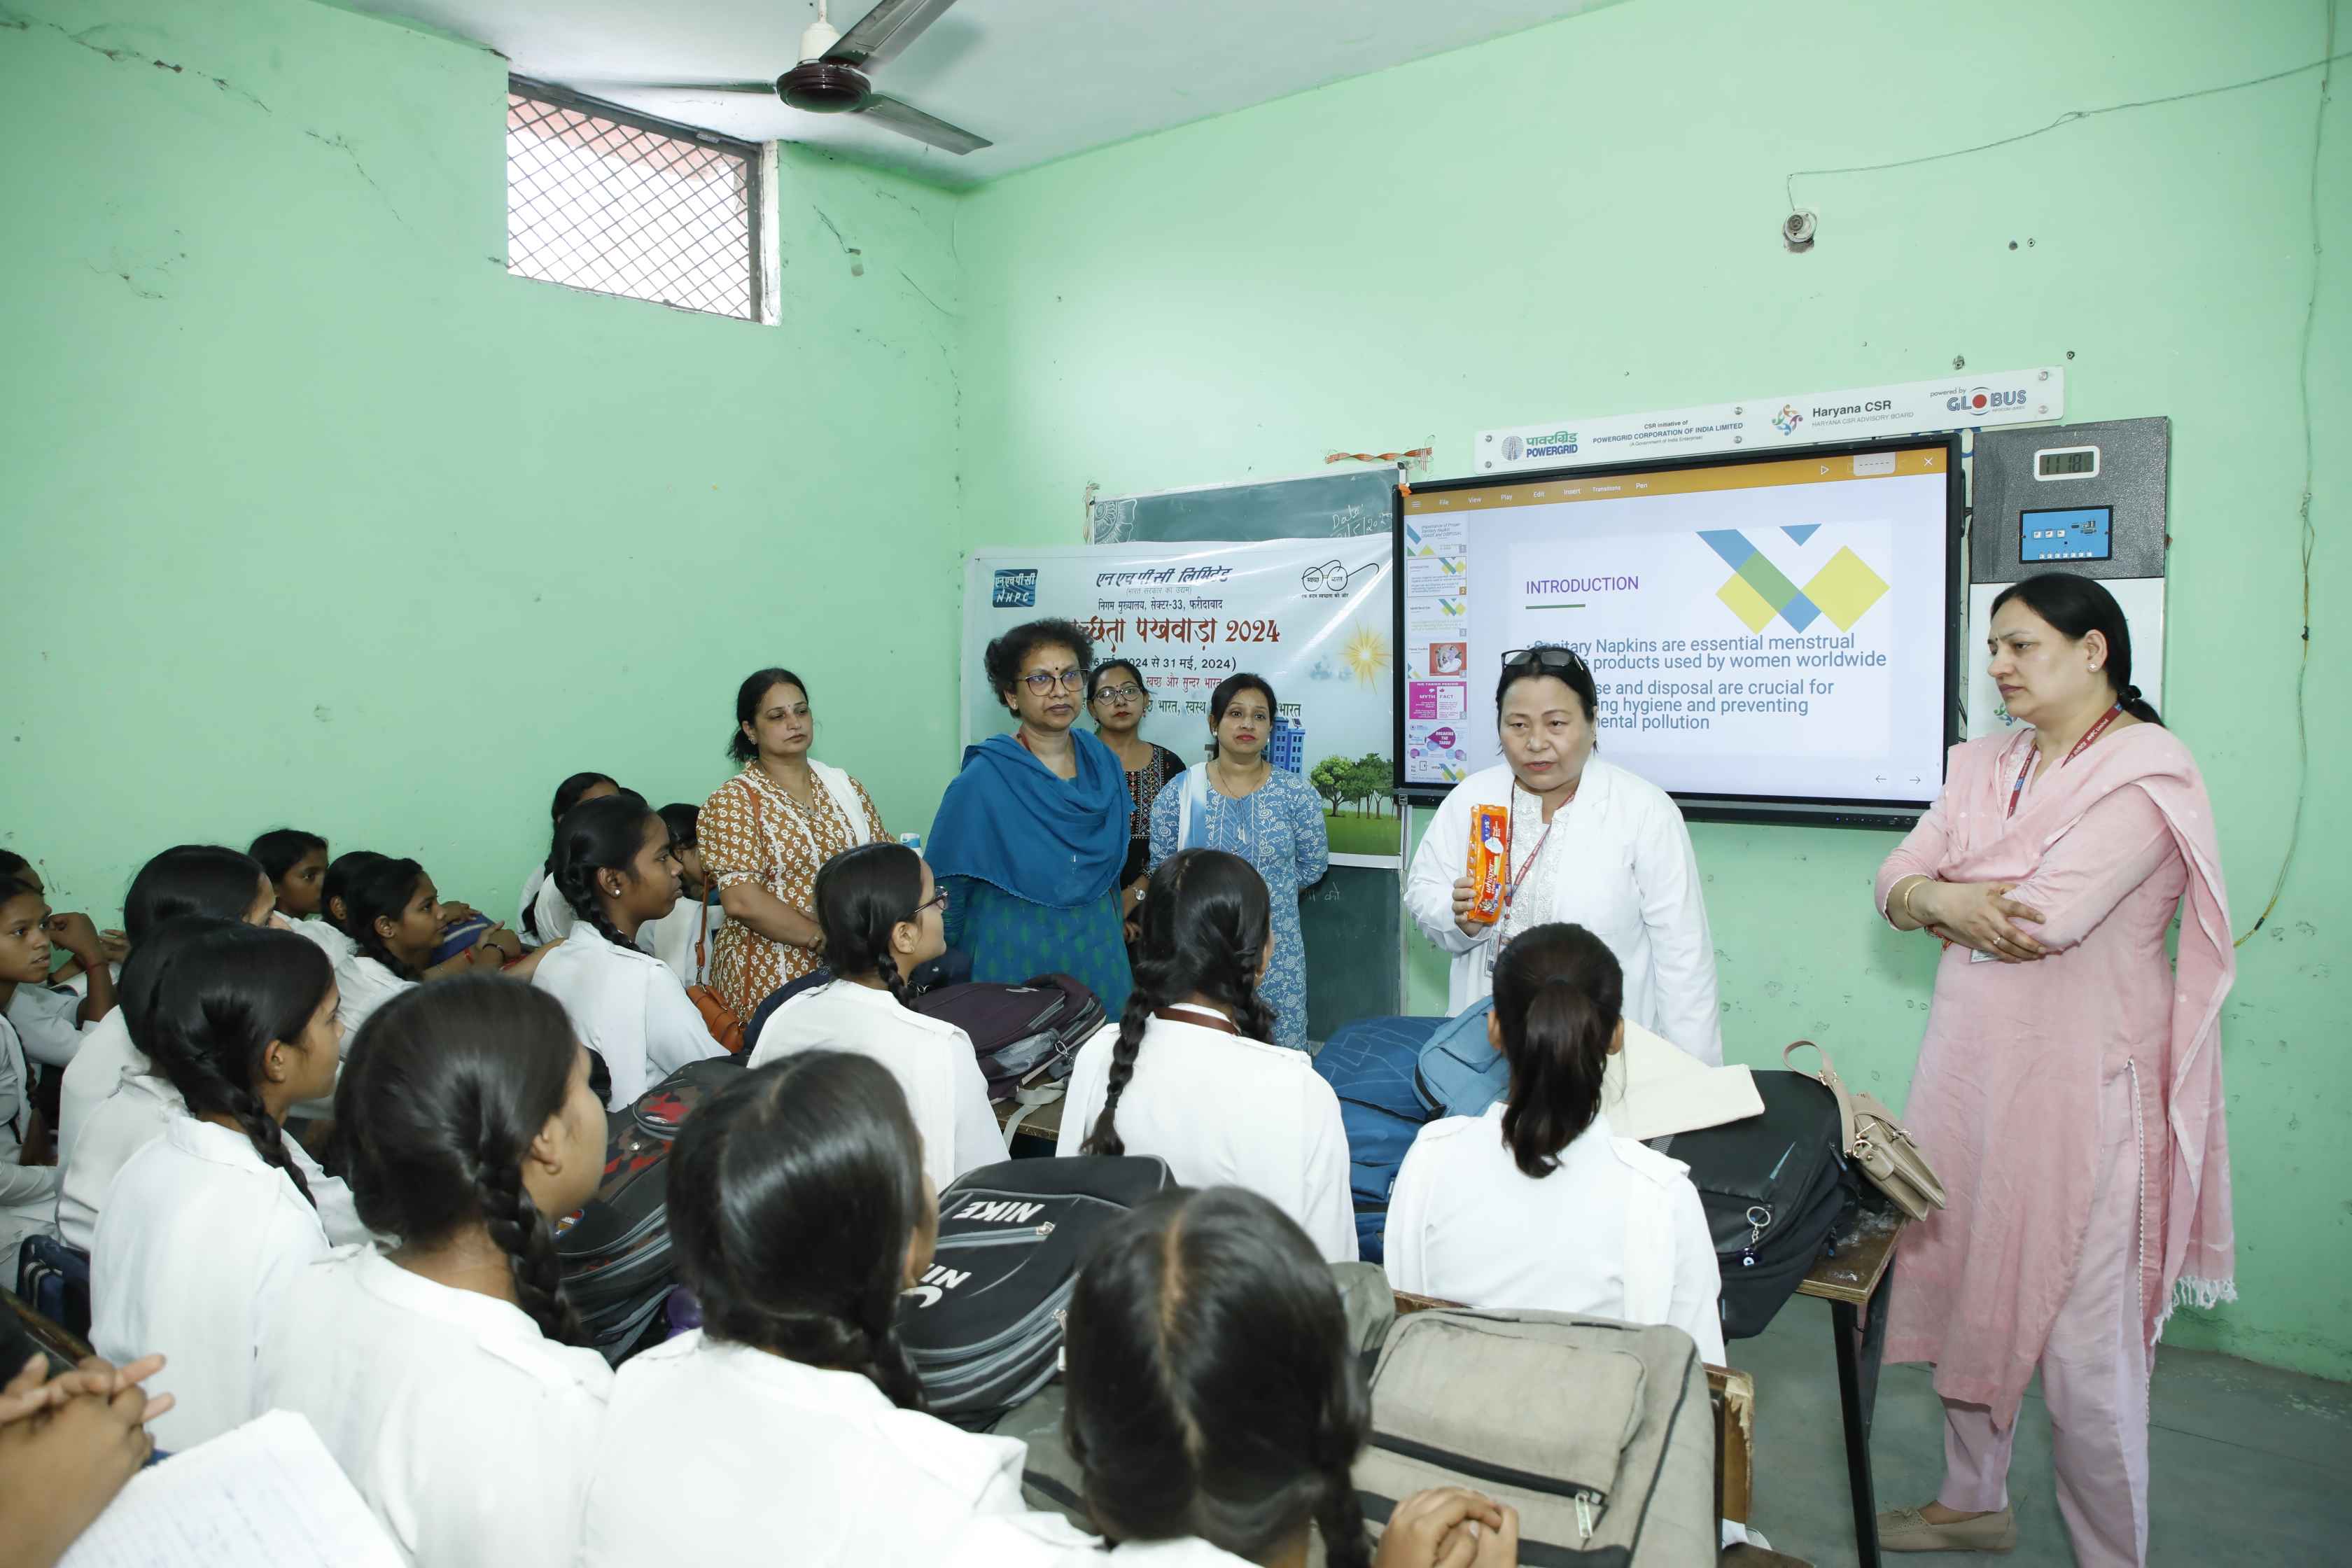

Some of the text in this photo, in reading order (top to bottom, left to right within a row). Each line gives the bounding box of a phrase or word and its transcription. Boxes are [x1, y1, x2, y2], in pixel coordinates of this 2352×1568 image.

[1930, 388, 1957, 398] powered
[1947, 388, 2027, 414] GLOBUS
[1813, 400, 1891, 418] Haryana CSR
[1856, 414, 1889, 423] ADVISORY
[1526, 431, 1578, 446] पावरग्रिड
[1592, 433, 1632, 443] POWERGRID
[1634, 429, 1682, 440] CORPORATION
[1716, 423, 1743, 431] LIMITED
[1527, 444, 1578, 458] POWERGRID
[1526, 575, 1639, 594] INTRODUCTION
[1098, 598, 1114, 610] निगम
[1190, 596, 1223, 610] फरीदाबाद
[1136, 616, 1218, 651] पखवाड़ा
[1225, 620, 1280, 643] 2024
[1597, 638, 1657, 656] Napkins
[1662, 640, 1686, 652] are
[1690, 635, 1763, 652] essential
[1769, 633, 1854, 650] menstrual
[1152, 655, 1160, 668] से
[1163, 658, 1176, 668] 31
[1201, 657, 1236, 672] 2024)
[1594, 654, 1660, 672] products
[1665, 653, 1702, 668] used
[1708, 653, 1726, 672] by
[1730, 655, 1791, 668] women
[1796, 650, 1886, 667] worldwide
[1616, 680, 1643, 694] and
[1648, 679, 1713, 698] disposal
[1718, 682, 1744, 694] are
[1748, 679, 1804, 694] crucial
[1809, 678, 1835, 694] for
[1278, 703, 1301, 718] भारत
[1623, 697, 1682, 715] hygiene
[1687, 697, 1715, 712] and
[1721, 698, 1809, 716] preventing
[1642, 713, 1710, 732] pollution
[952, 1201, 1046, 1224] NIKE
